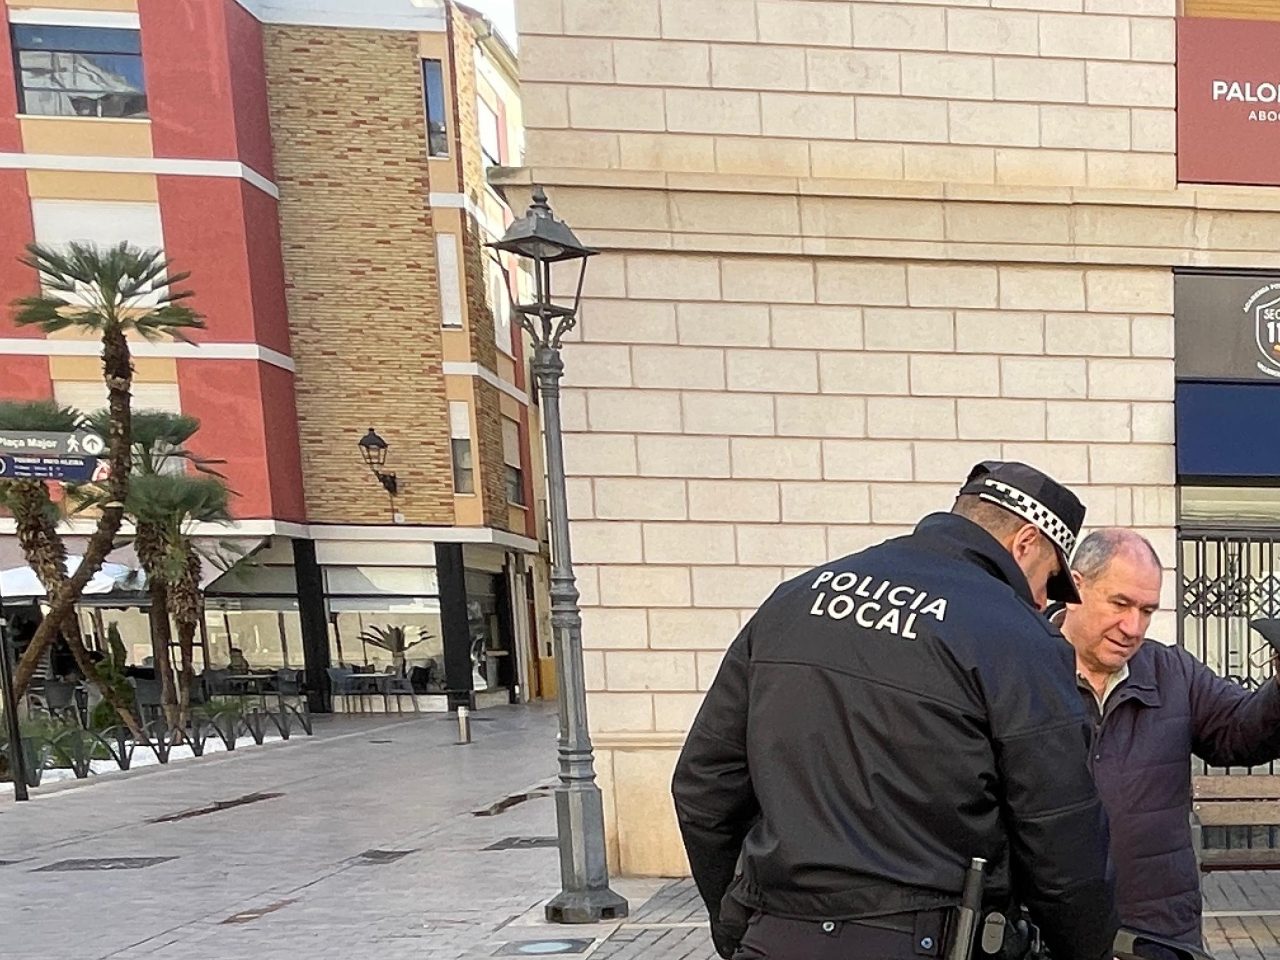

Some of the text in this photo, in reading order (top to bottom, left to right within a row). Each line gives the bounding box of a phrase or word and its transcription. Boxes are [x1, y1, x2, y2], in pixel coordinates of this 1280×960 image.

[27, 437, 58, 450] Major
[810, 592, 917, 640] LOCAL
[811, 571, 948, 622] POLICIA
